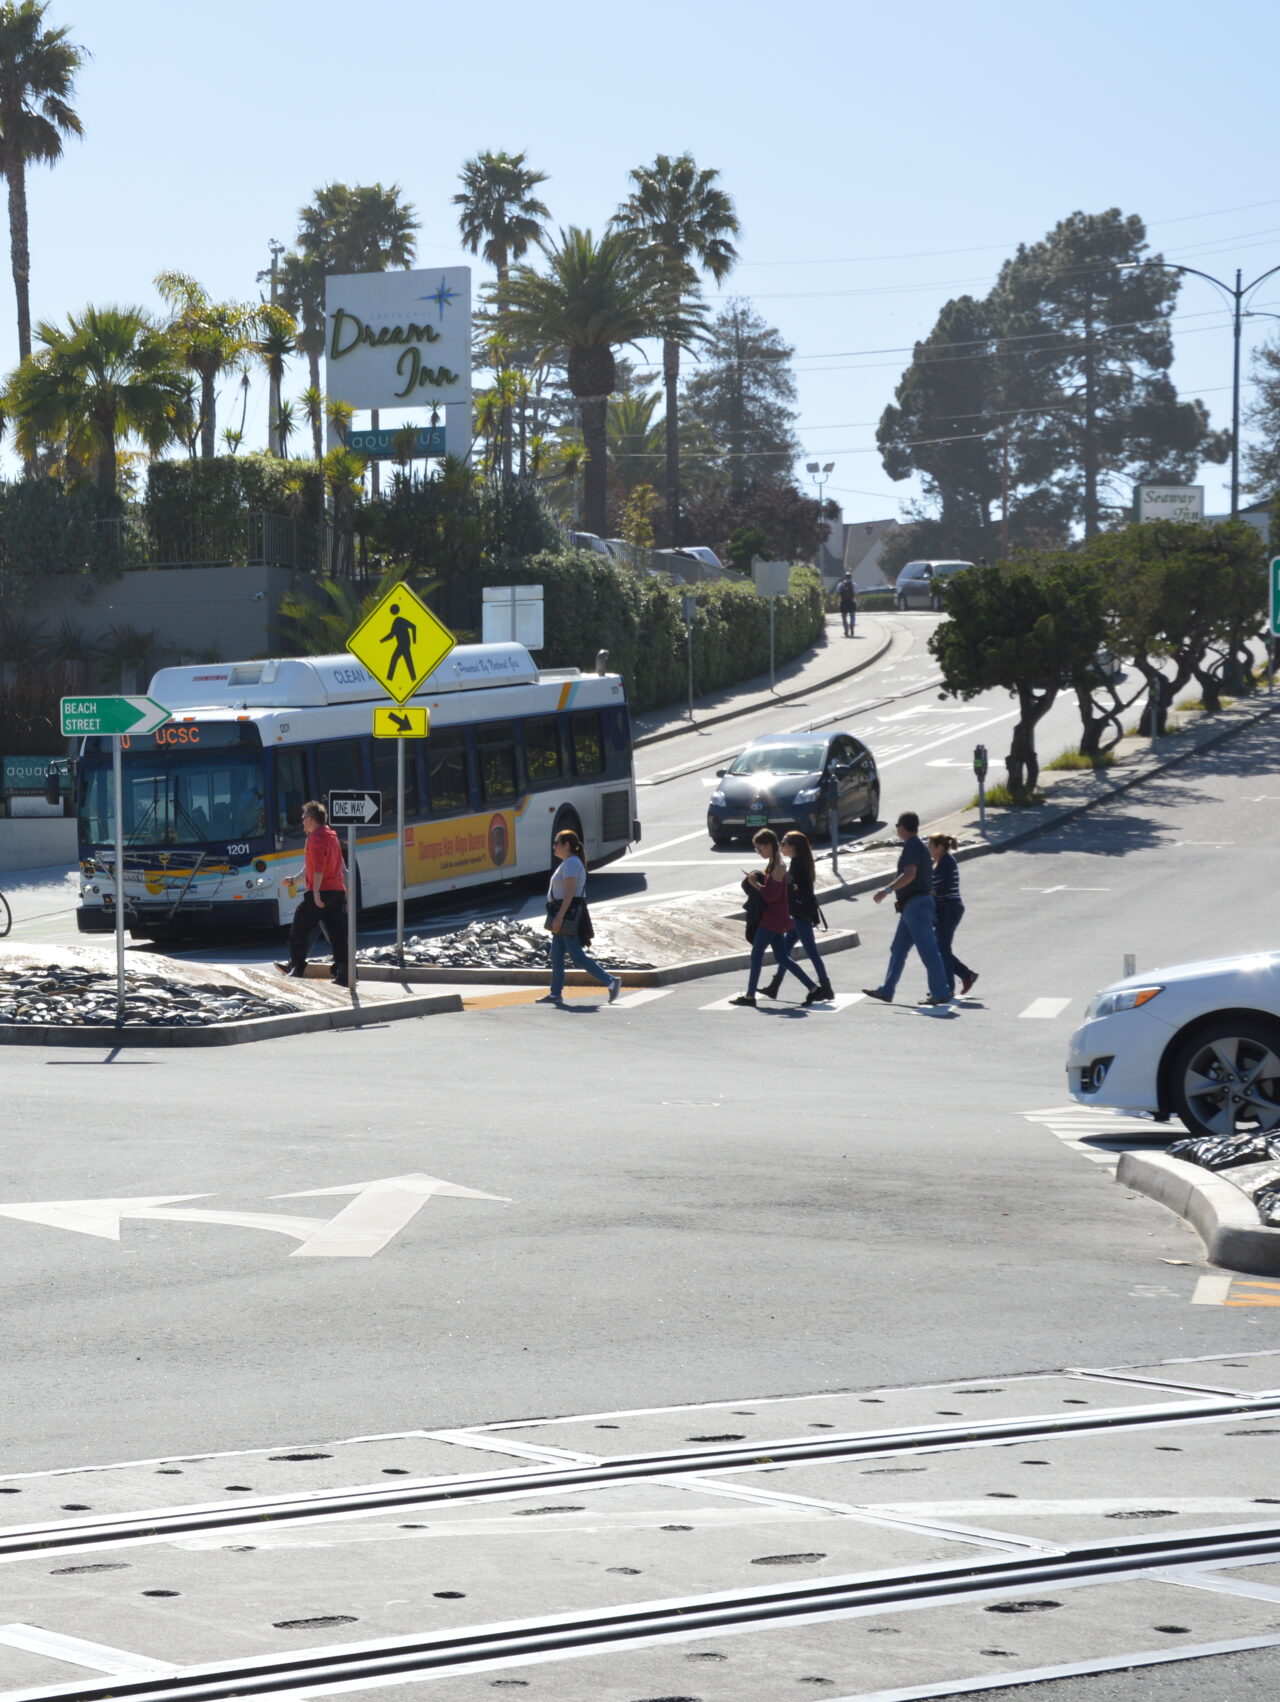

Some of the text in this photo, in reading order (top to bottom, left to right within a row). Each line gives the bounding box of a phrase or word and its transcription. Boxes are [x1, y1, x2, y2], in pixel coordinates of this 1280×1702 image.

[330, 307, 440, 361] Dream
[394, 346, 459, 398] Inn
[333, 669, 366, 684] CLEAN
[64, 702, 97, 714] BEACH
[65, 718, 101, 731] STREET
[155, 726, 200, 745] UCSC
[334, 801, 365, 815] ONE WAY
[226, 843, 250, 856] 1201
